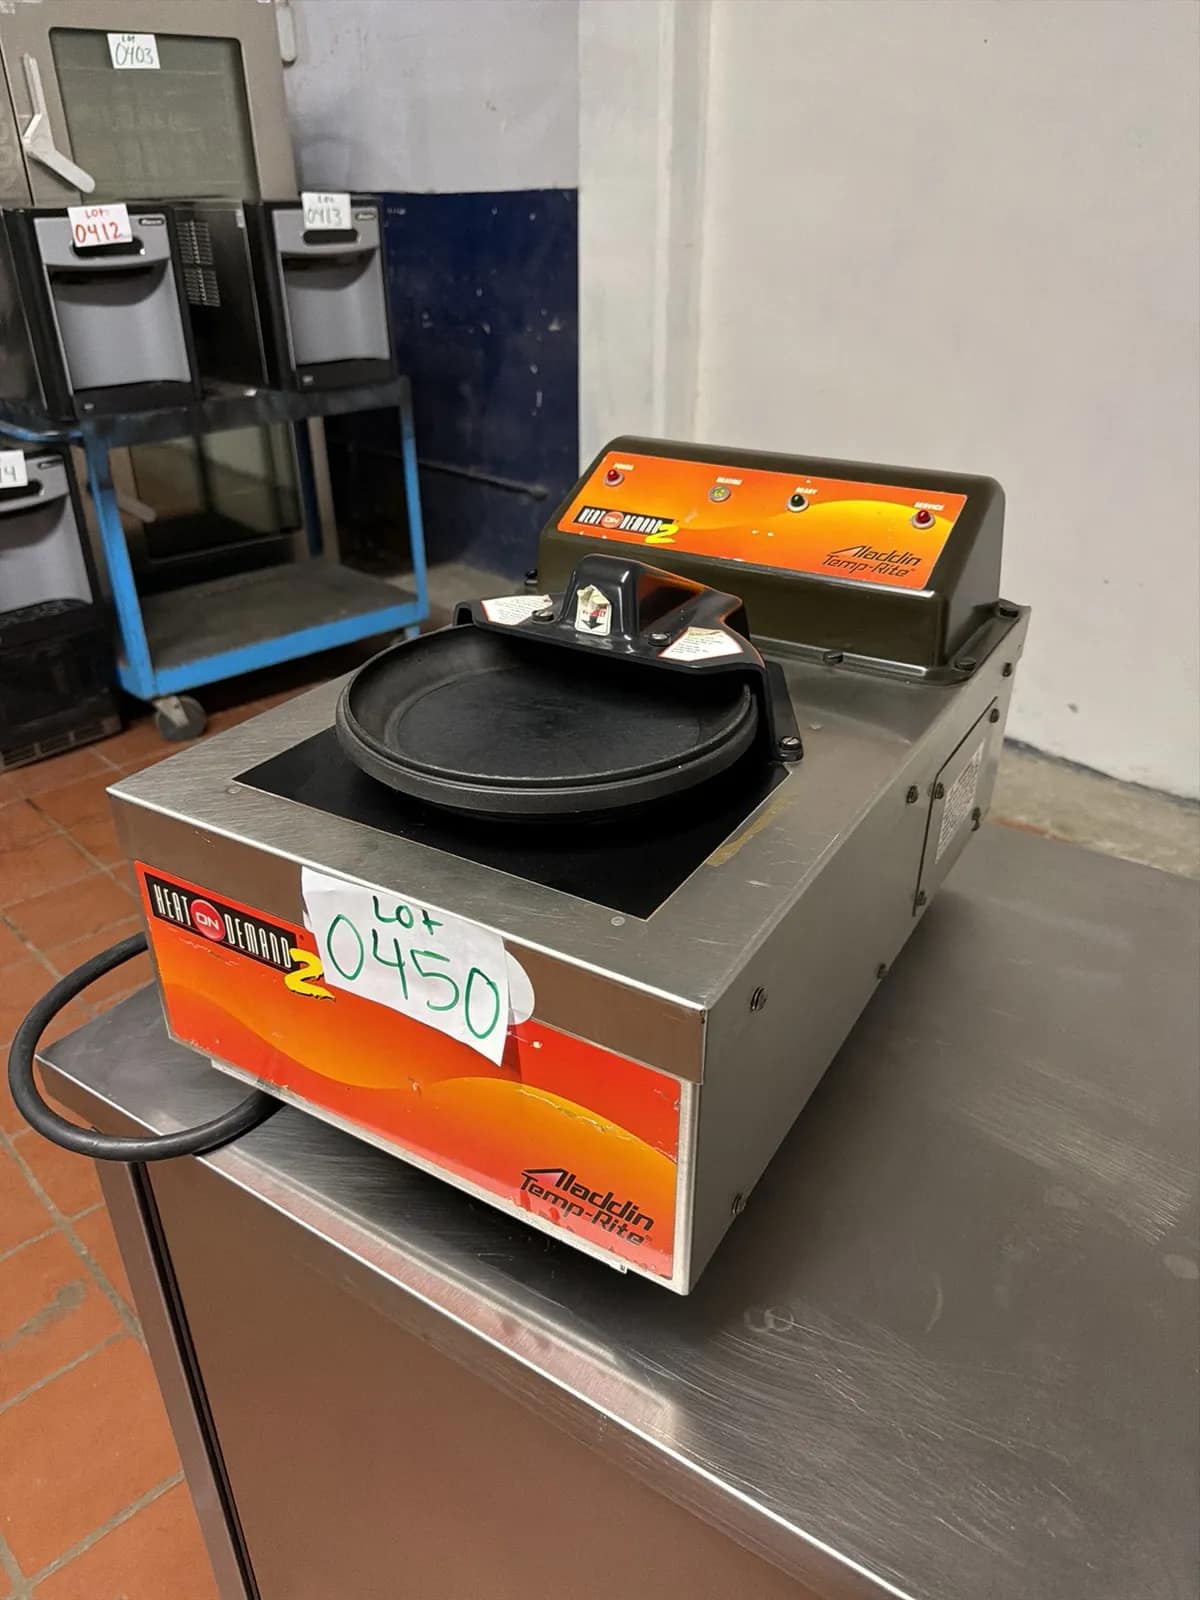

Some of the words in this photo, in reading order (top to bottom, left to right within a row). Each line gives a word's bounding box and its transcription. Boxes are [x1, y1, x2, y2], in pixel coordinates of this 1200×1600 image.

[115, 42, 153, 65] 0403
[75, 221, 123, 243] 0412
[914, 502, 944, 512] SERVICE
[577, 508, 606, 525] HEAT
[644, 523, 680, 544] 2
[831, 544, 922, 566] Aladdin
[153, 883, 192, 934] HEAT
[195, 911, 220, 931] ON
[224, 914, 293, 970] DEMAND
[284, 948, 336, 1002] 2
[326, 913, 501, 1040] 0450
[521, 1167, 655, 1232] Aladdin
